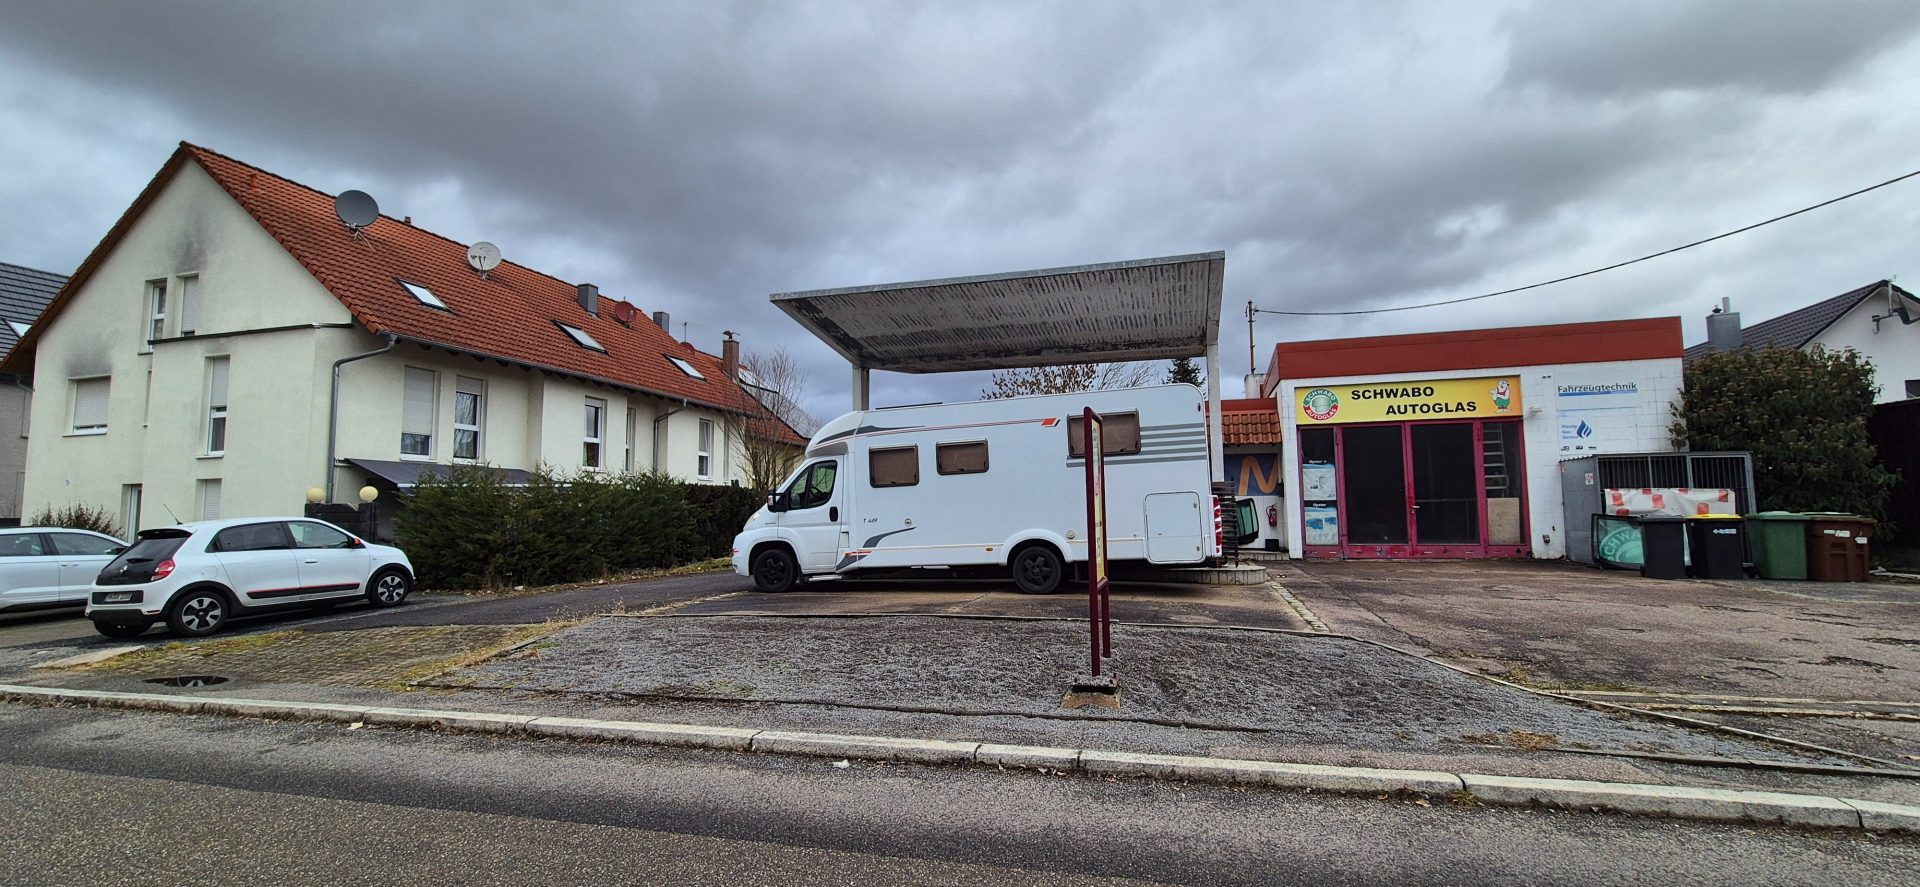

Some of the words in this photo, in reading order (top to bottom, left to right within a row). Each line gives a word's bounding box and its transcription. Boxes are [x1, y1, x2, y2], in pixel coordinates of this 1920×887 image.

[1351, 386, 1435, 400] SCHWABO
[1557, 382, 1637, 393] Fahrzeugtechnik
[1305, 408, 1337, 420] AUTOGLAS
[1385, 401, 1477, 415] AUTOGLAS
